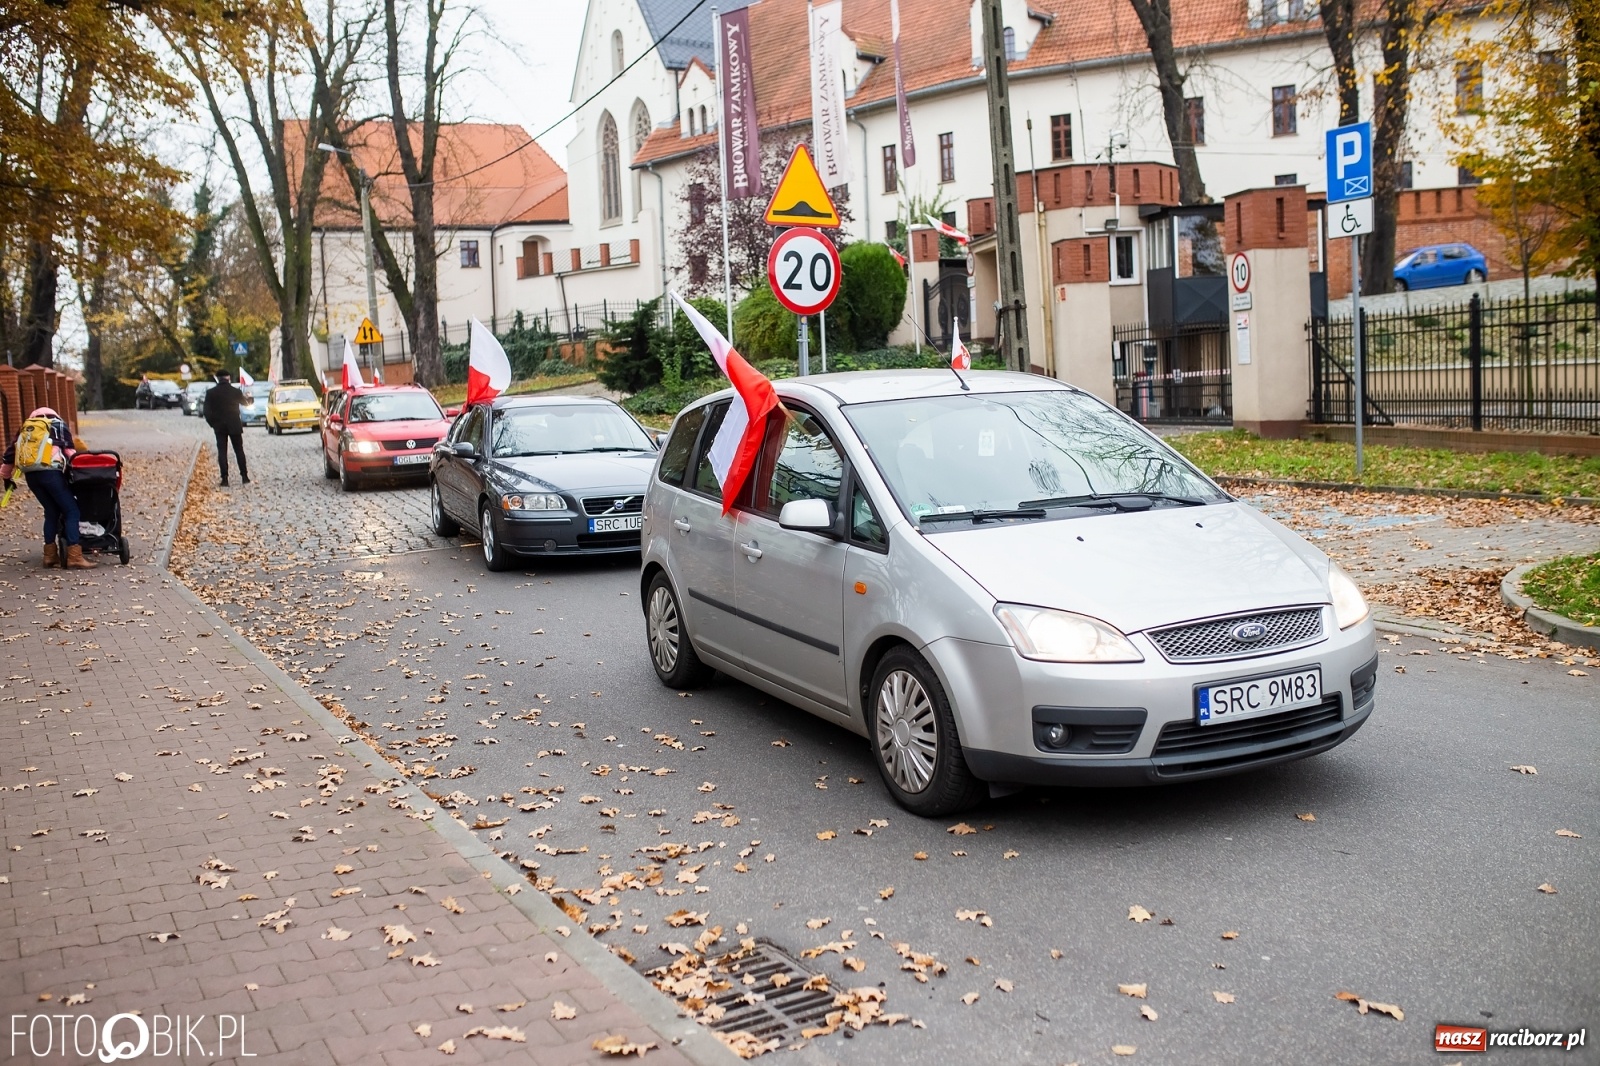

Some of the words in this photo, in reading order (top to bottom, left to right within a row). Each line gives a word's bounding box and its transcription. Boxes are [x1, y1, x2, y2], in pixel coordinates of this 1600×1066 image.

[726, 22, 743, 116] ZAMKOWY
[819, 16, 830, 101] ZAMKOWY
[731, 120, 749, 189] BROWAR
[821, 107, 838, 177] BROWAR
[1336, 131, 1362, 180] P
[782, 250, 832, 291] 20
[1235, 263, 1247, 282] 10
[596, 518, 620, 531] SRC
[1242, 626, 1261, 638] Ford
[1200, 707, 1209, 716] PL
[1213, 684, 1261, 715] SRC
[1268, 673, 1317, 706] 9M83
